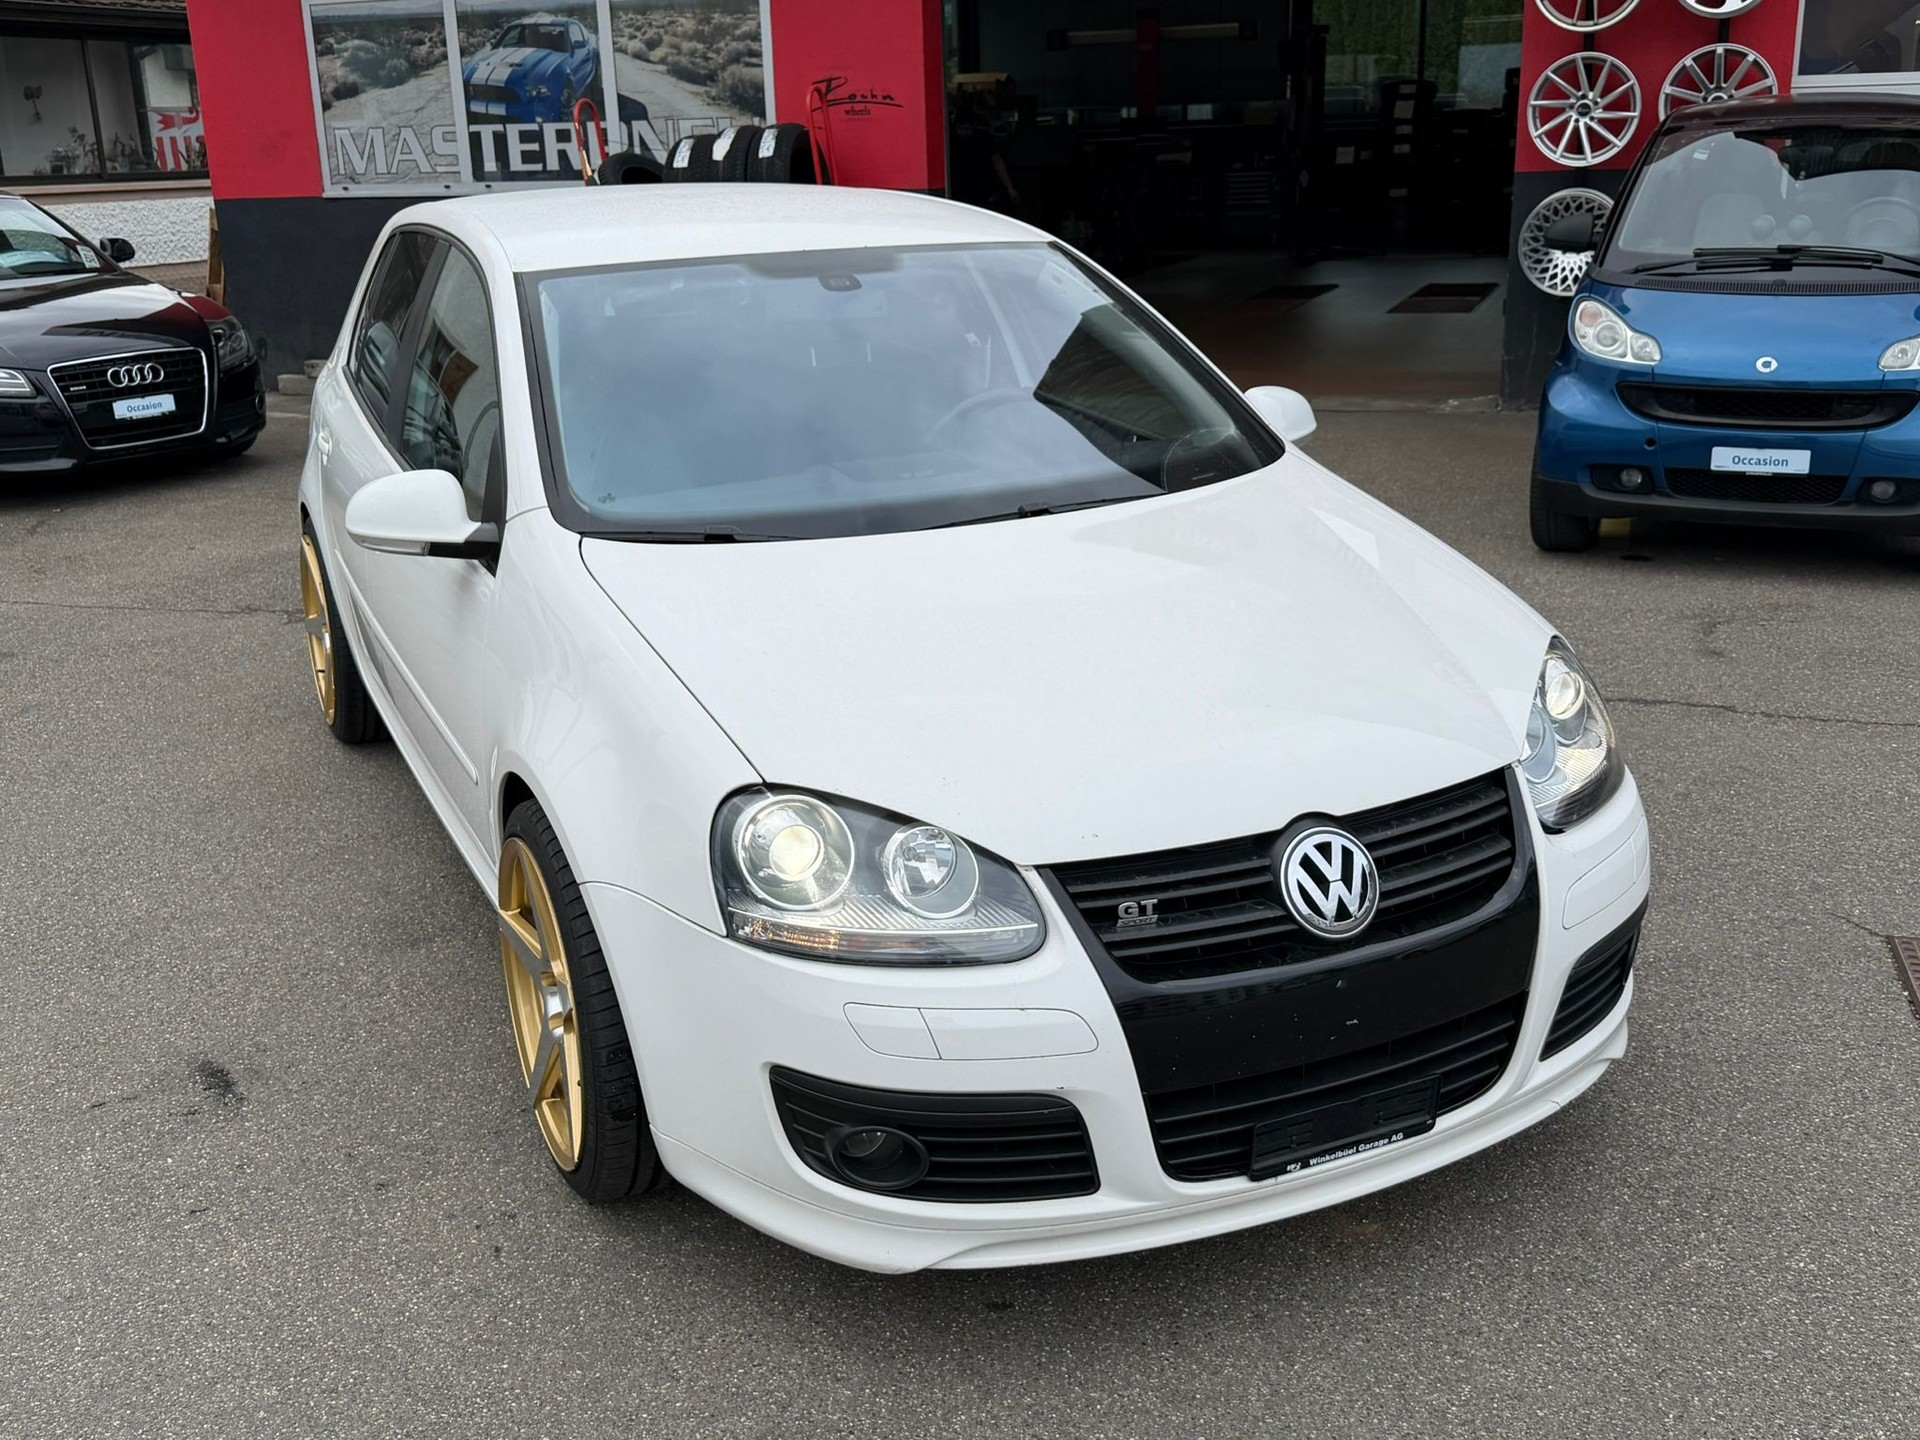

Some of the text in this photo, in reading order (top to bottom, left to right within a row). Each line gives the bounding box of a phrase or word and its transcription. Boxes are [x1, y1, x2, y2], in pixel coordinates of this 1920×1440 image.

[127, 401, 162, 413] Occasion
[1732, 455, 1789, 467] Occasion
[1118, 899, 1158, 918] GT
[1309, 1132, 1404, 1166] Winkelbüel Garage AG
